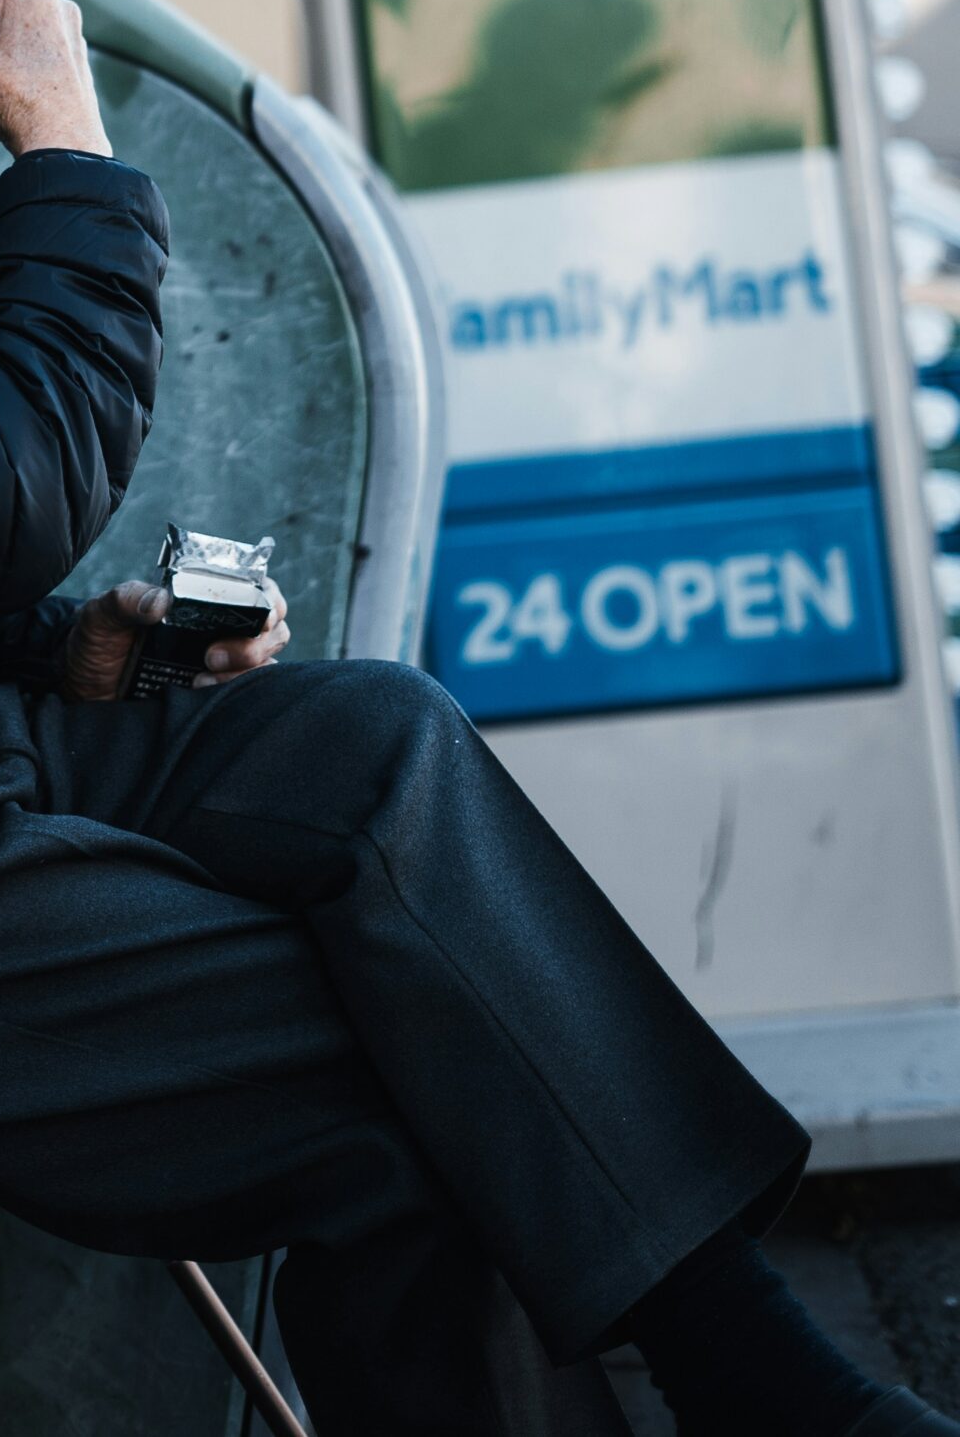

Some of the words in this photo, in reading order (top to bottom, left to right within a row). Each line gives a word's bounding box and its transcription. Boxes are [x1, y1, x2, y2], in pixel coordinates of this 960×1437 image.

[443, 248, 831, 351] amilyMart
[457, 574, 571, 663] 24
[581, 547, 853, 651] OPEN
